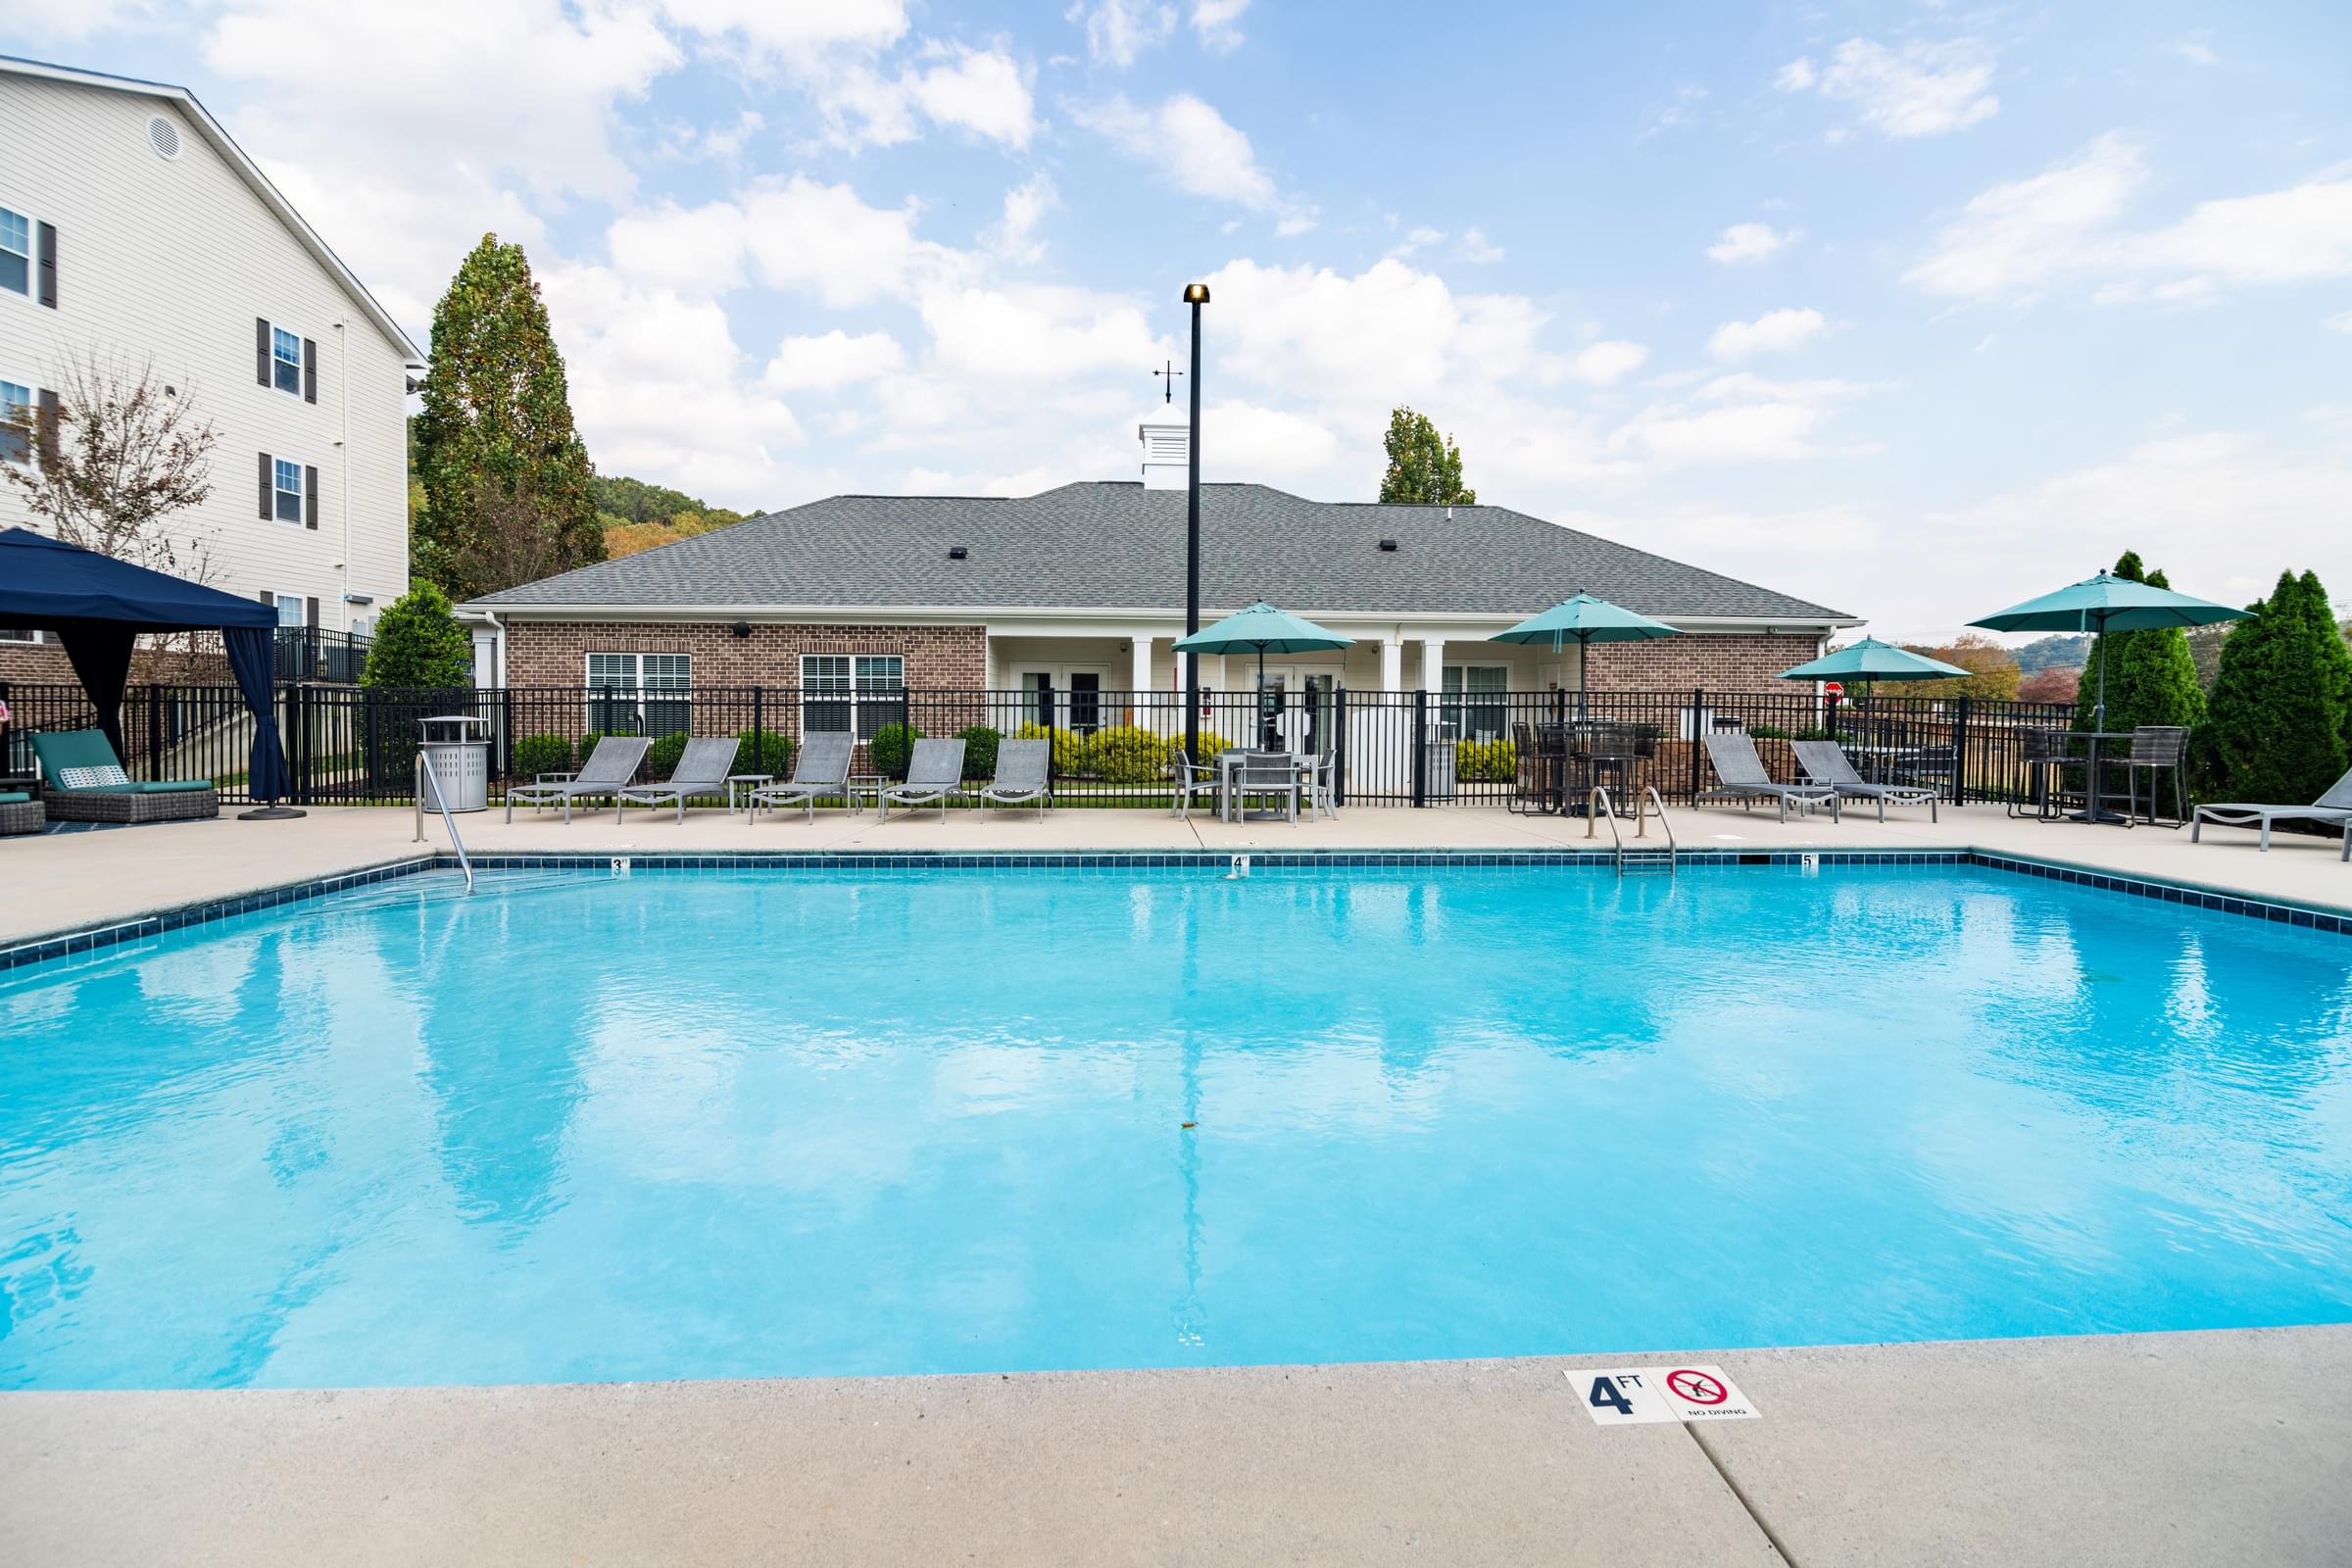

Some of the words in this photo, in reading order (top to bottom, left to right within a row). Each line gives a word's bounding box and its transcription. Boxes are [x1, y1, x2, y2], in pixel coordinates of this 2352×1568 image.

[613, 858, 621, 869] 3
[1234, 856, 1242, 866] 4
[1803, 855, 1811, 865] 5
[1589, 1376, 1634, 1415] 4
[1616, 1375, 1642, 1389] FT
